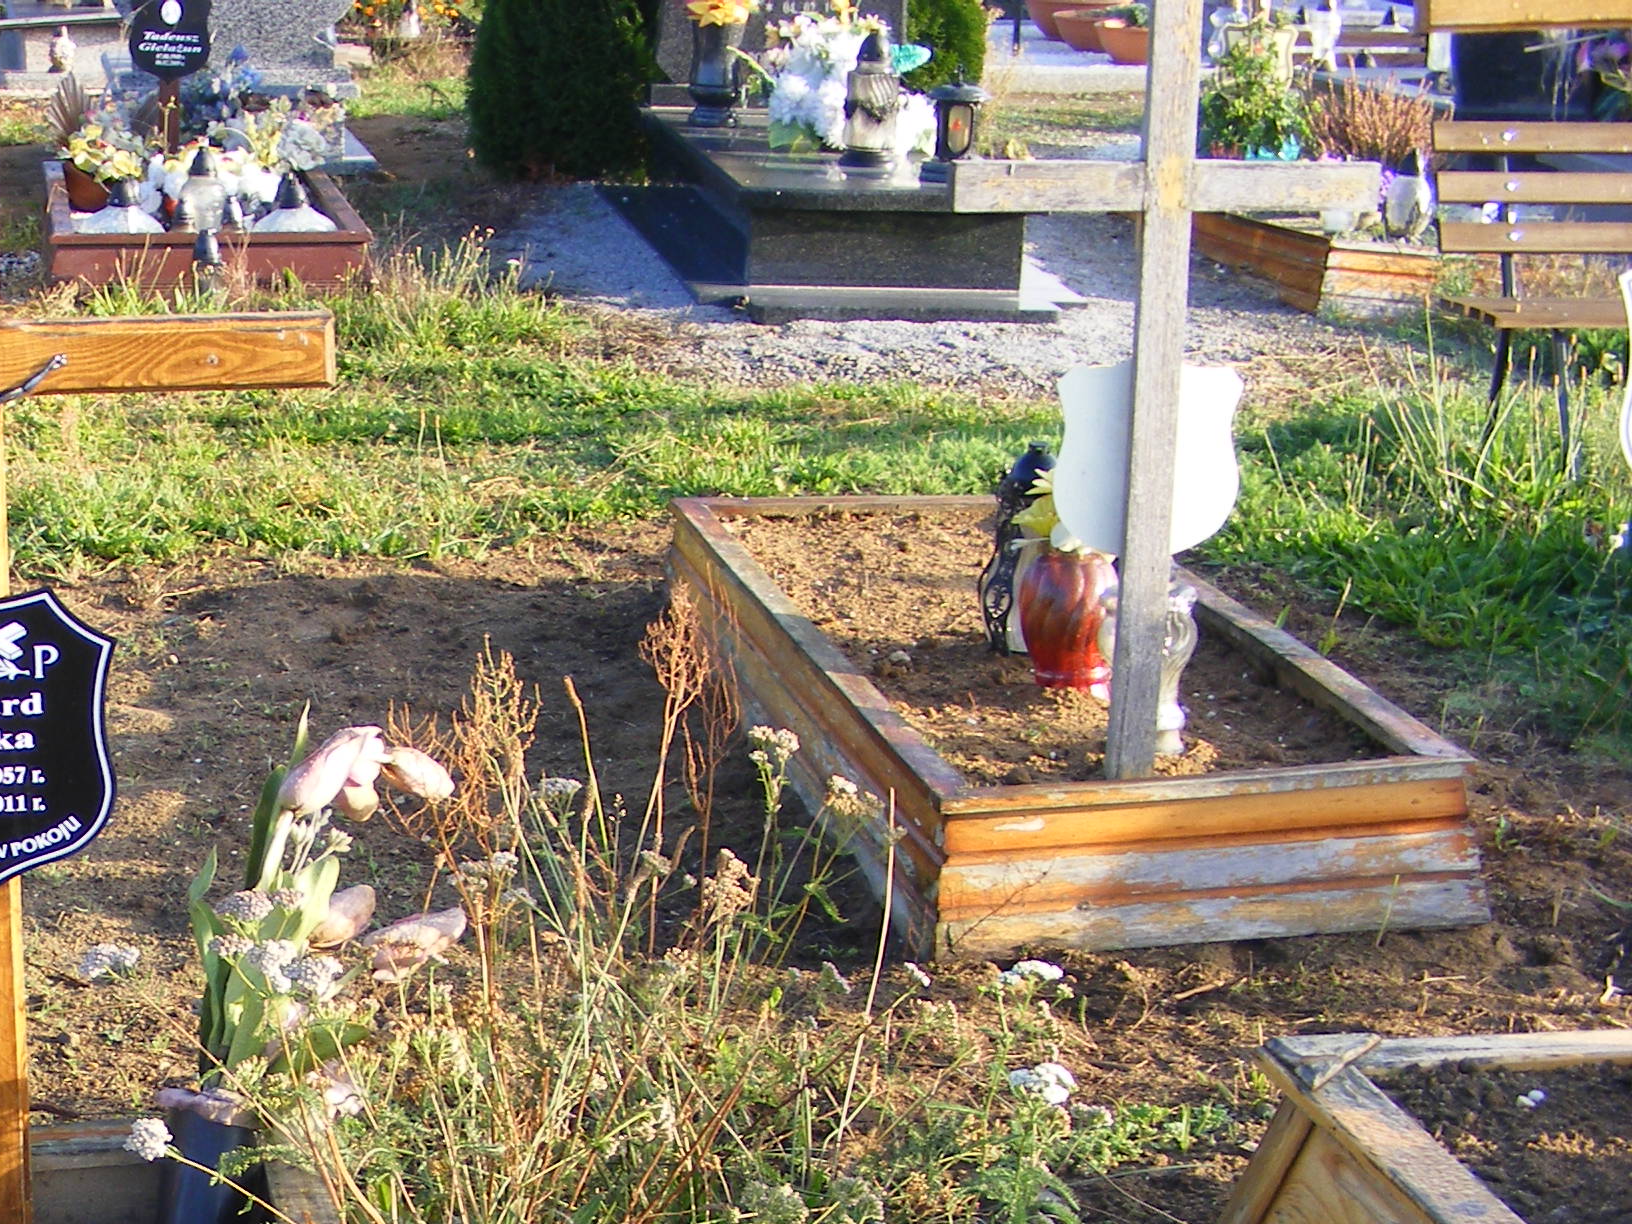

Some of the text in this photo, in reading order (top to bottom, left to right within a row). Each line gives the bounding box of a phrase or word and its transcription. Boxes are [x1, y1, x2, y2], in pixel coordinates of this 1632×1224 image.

[143, 31, 199, 42] Tadeusz
[33, 645, 59, 679] P
[31, 769, 45, 784] r.
[31, 798, 46, 812] r.
[10, 815, 82, 857] POKOJU
